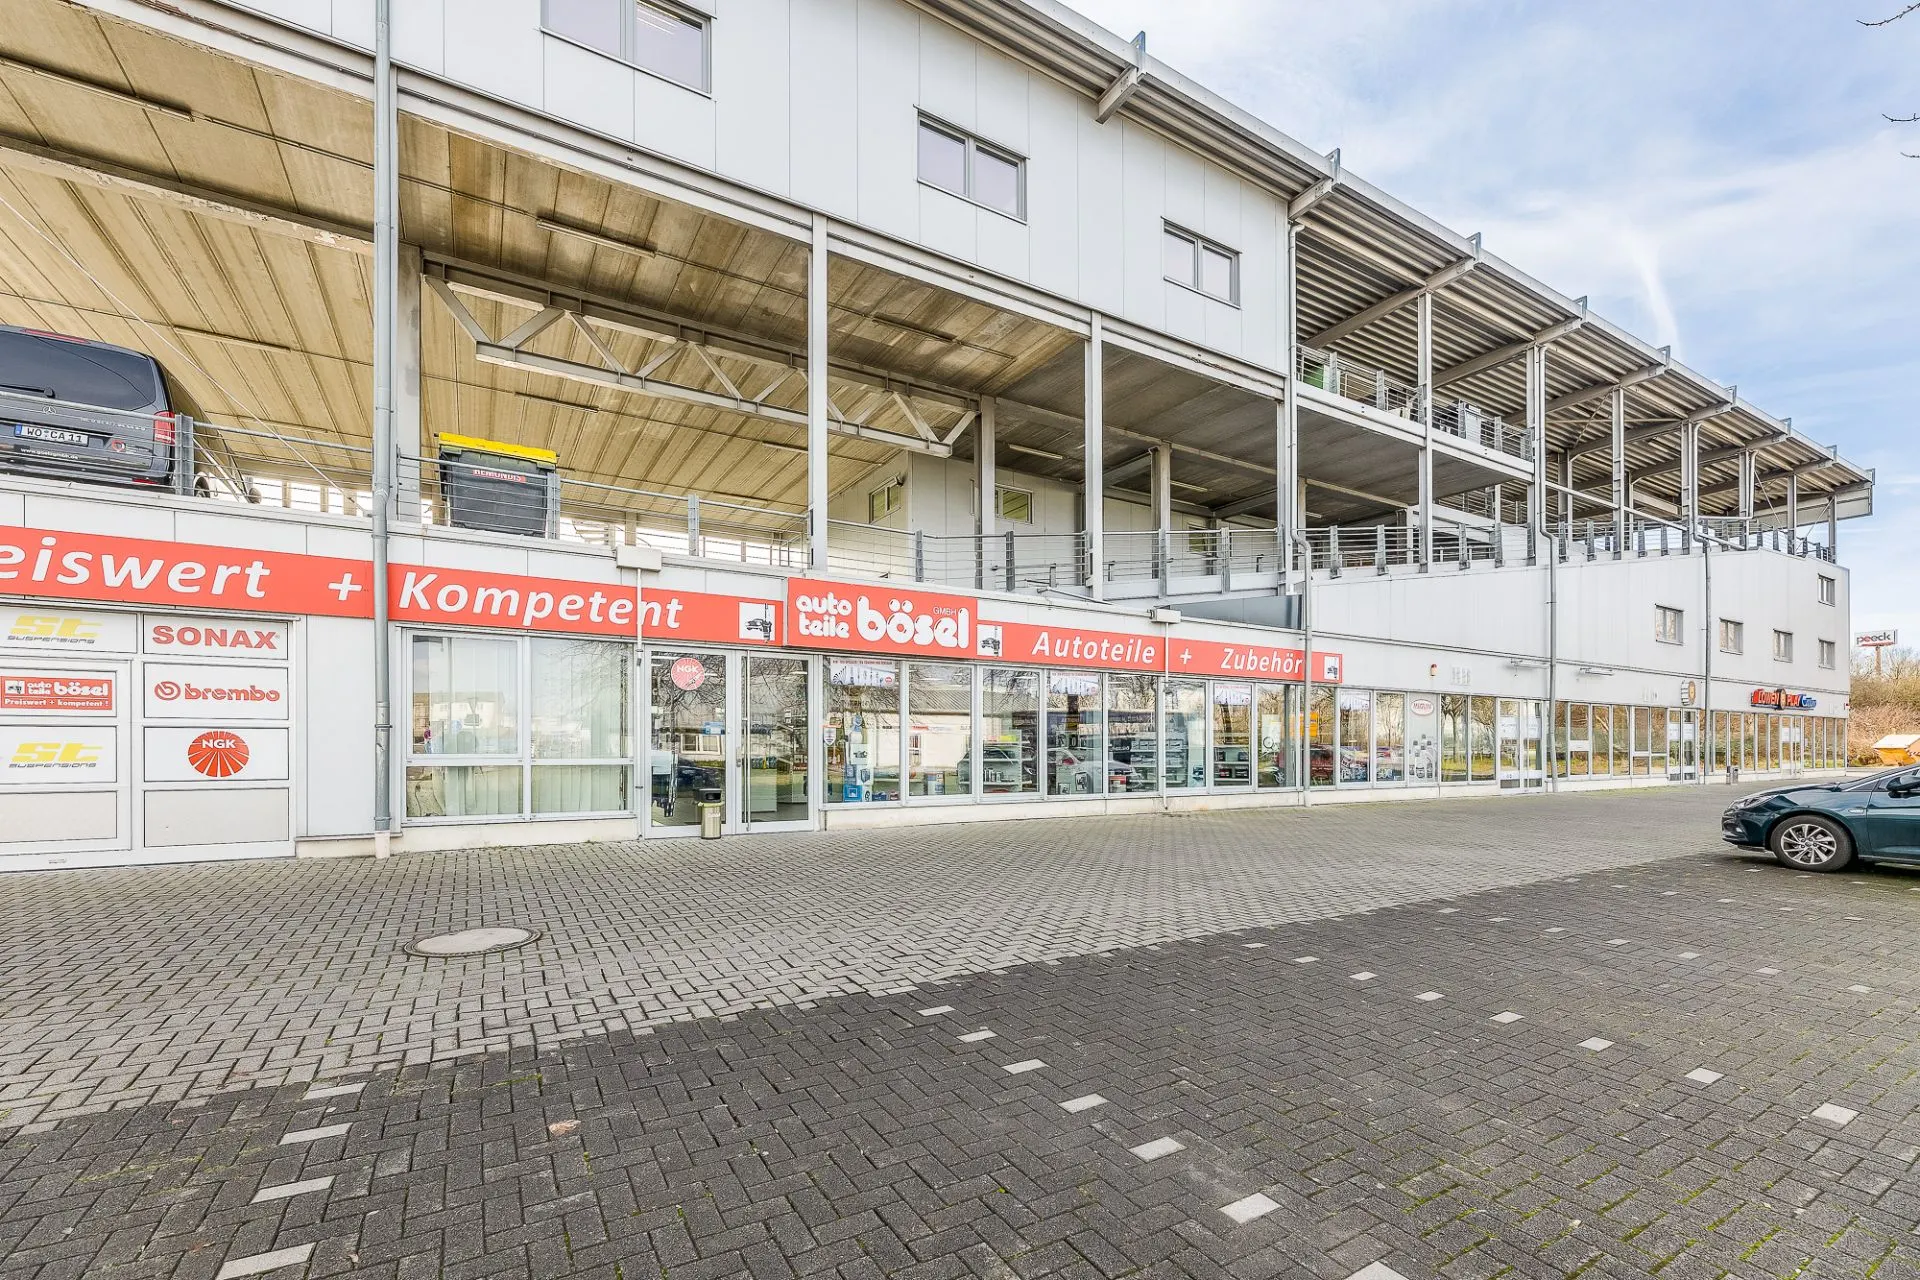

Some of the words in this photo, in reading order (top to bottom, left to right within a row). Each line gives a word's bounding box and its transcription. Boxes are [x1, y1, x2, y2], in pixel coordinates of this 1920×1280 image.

[27, 427, 42, 437] WO
[50, 431, 65, 441] CA
[68, 434, 82, 443] 11
[0, 537, 270, 598] eiswert
[327, 572, 363, 602] +
[398, 571, 684, 628] Kompetent
[795, 591, 853, 616] auto
[856, 594, 970, 649] bösel
[798, 612, 851, 639] teile
[152, 625, 277, 649] SONAX
[1032, 631, 1156, 665] Autoteile
[1179, 648, 1193, 666] +
[1220, 647, 1303, 675] Zubehör
[676, 665, 699, 675] NGK
[27, 681, 52, 690] auto
[54, 681, 109, 697] bösel
[184, 683, 280, 702] brembo
[5, 698, 47, 706] Preiswert
[58, 698, 103, 708] kompetent
[202, 739, 236, 749] NGK
